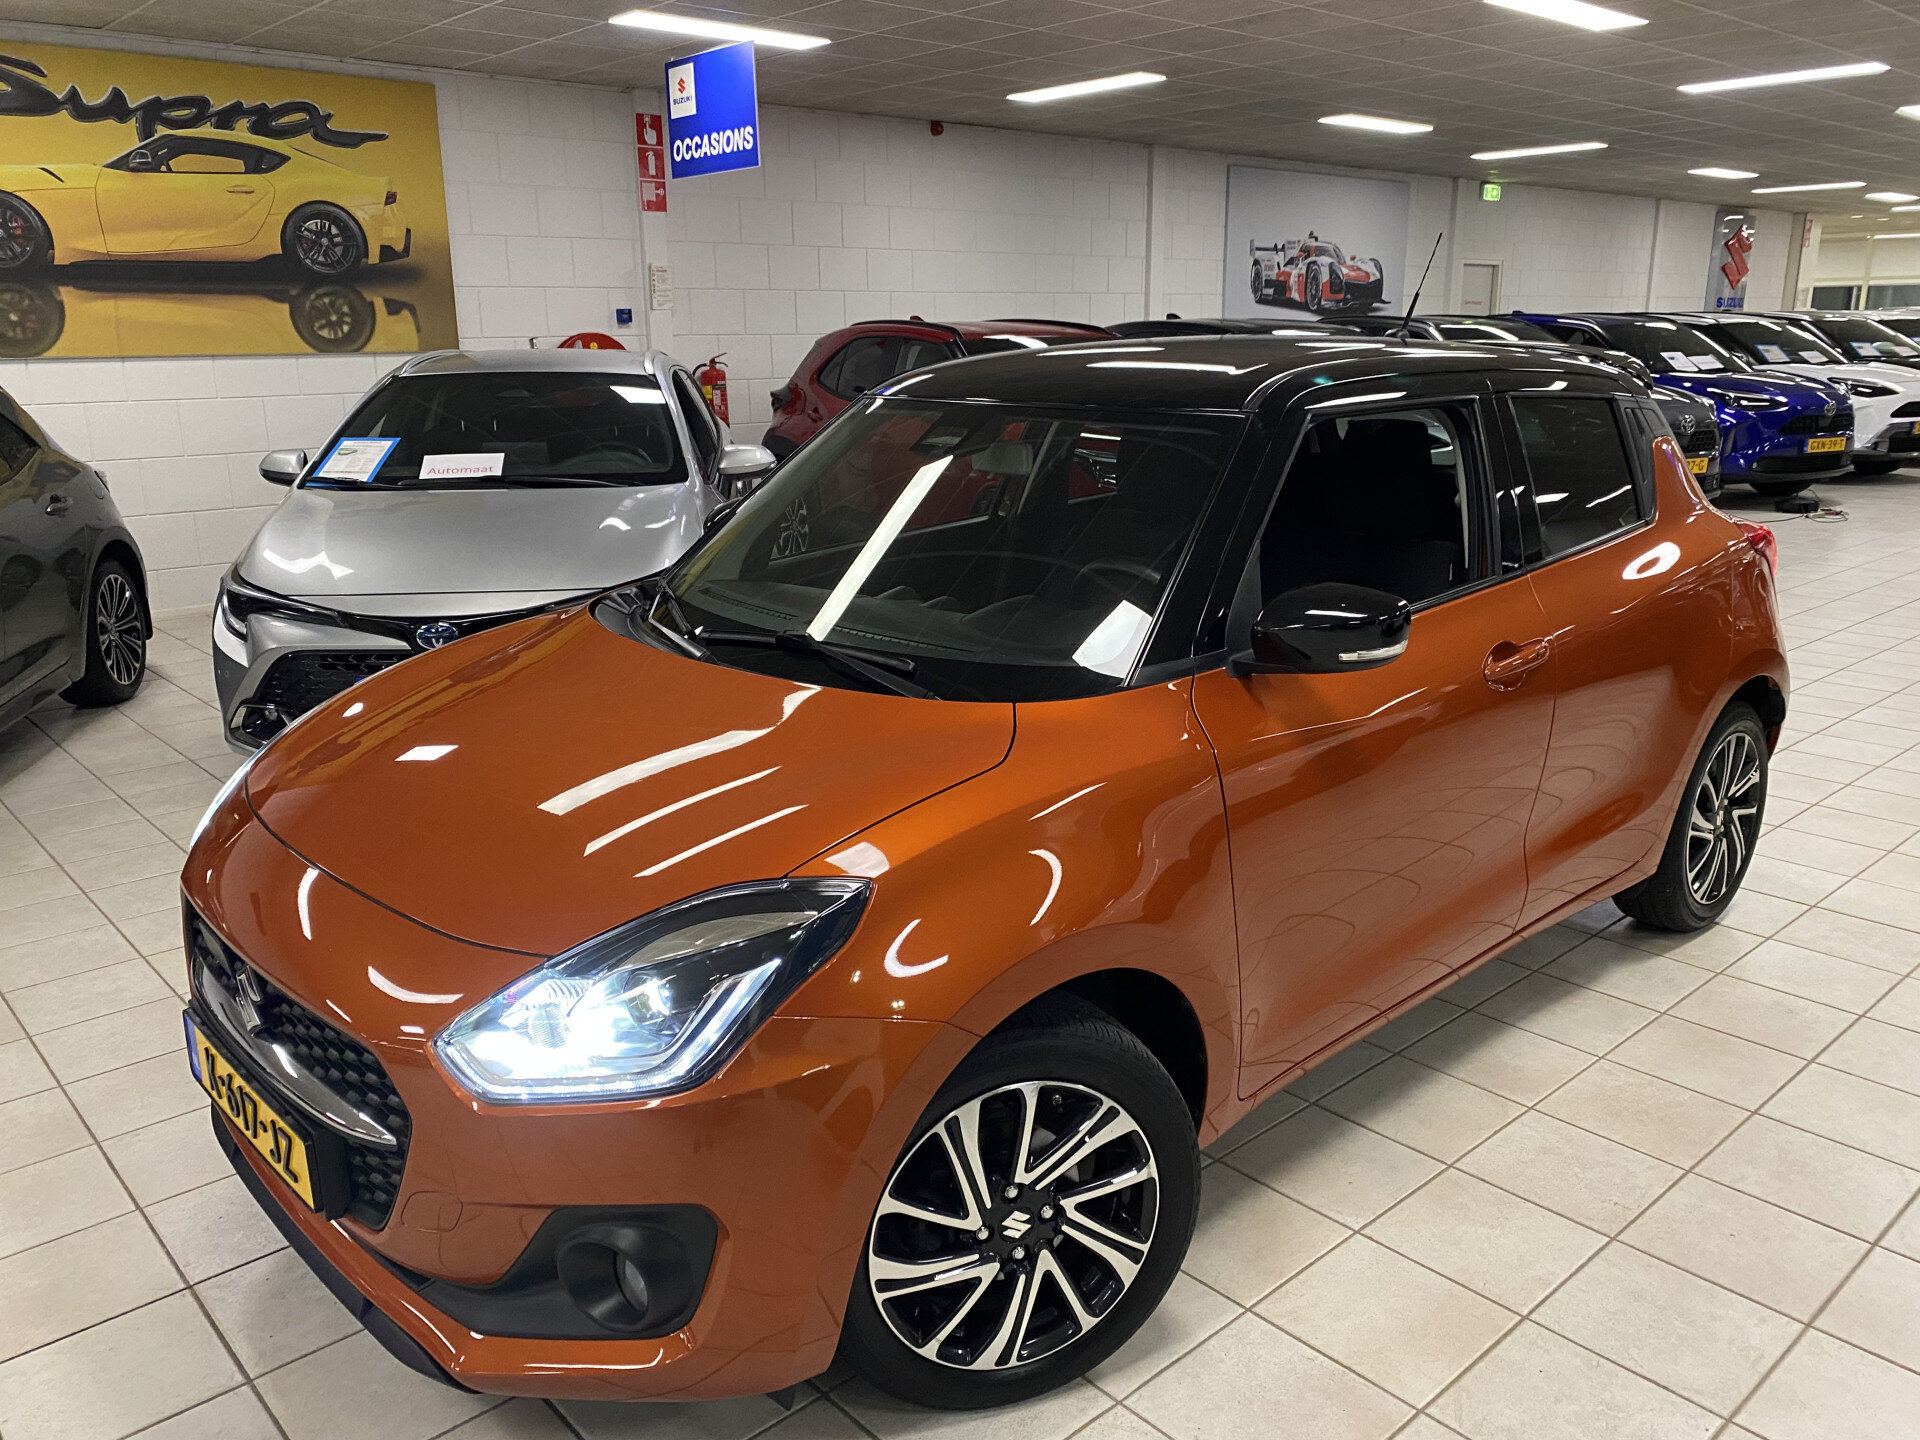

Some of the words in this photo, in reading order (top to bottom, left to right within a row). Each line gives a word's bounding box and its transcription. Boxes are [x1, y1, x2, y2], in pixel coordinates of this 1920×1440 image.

[673, 95, 693, 106] SUZUKI
[673, 126, 754, 162] OCCASIONS
[427, 465, 493, 475] Automaat
[204, 1046, 299, 1183] K-617-JZ
